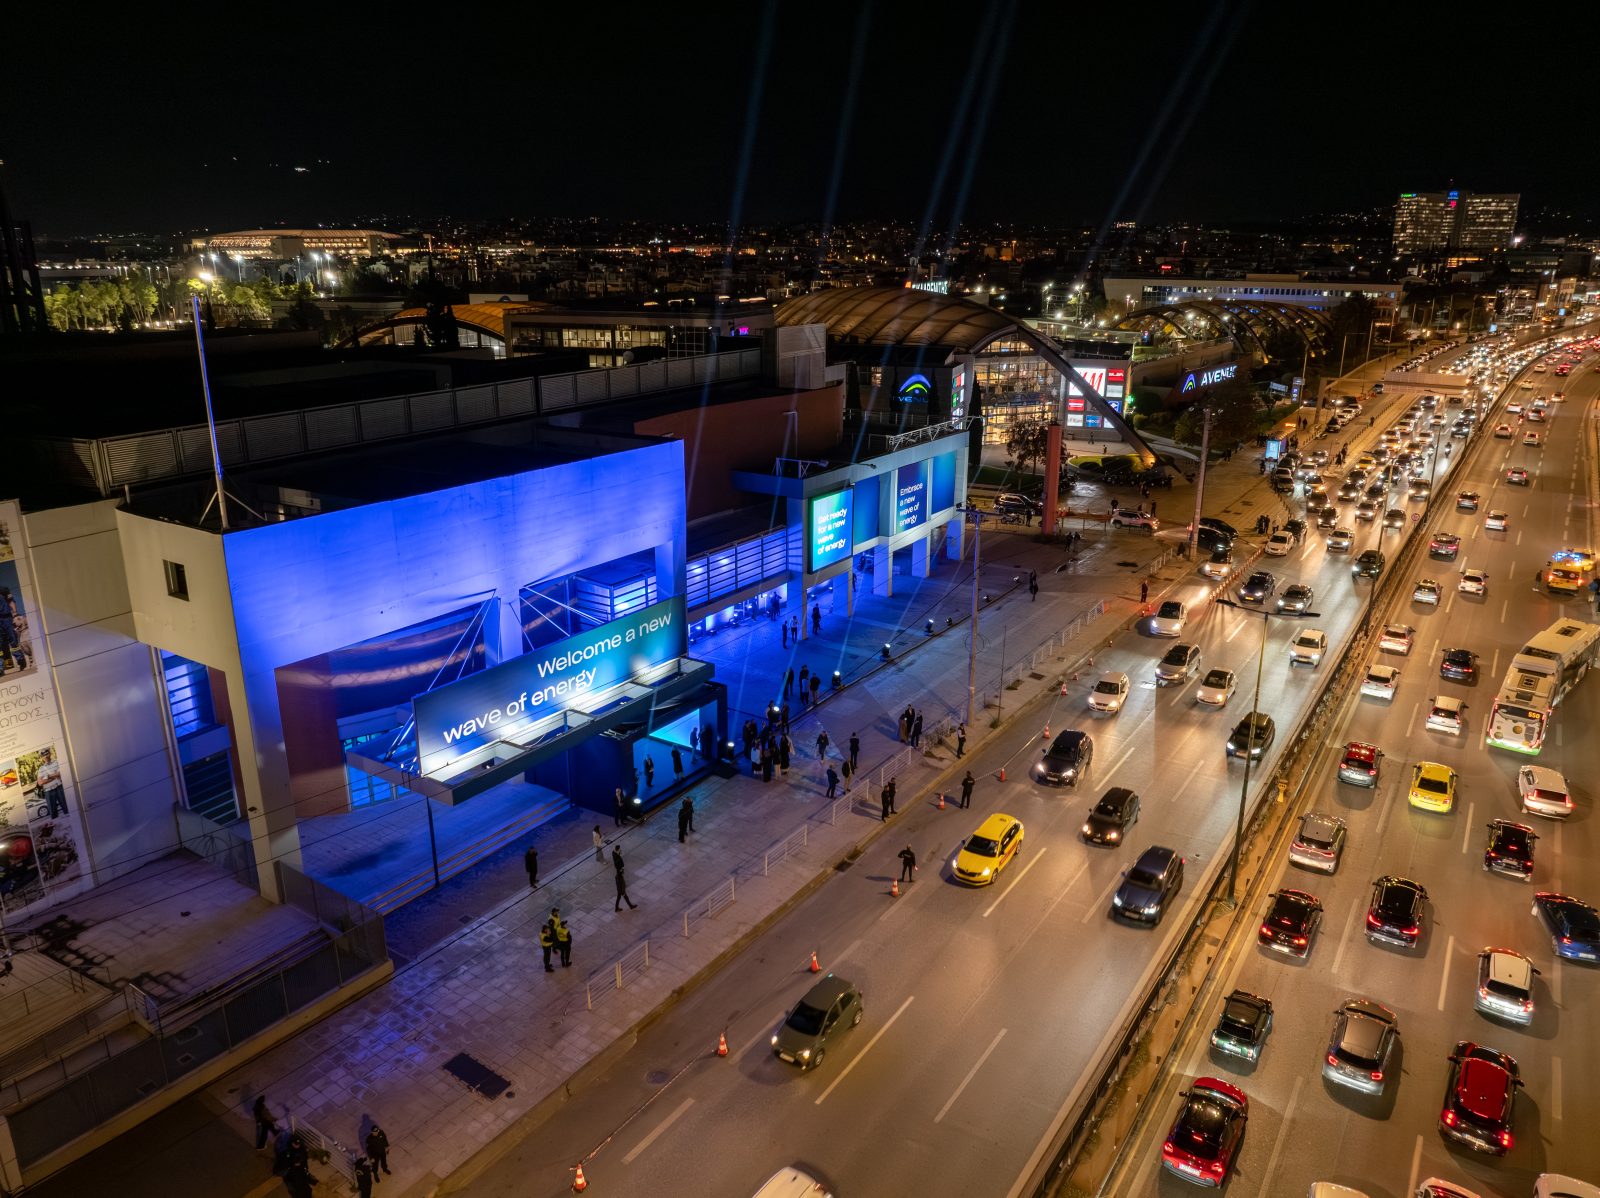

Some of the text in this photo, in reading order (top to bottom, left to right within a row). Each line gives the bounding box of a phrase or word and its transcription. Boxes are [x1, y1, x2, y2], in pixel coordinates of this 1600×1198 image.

[900, 482, 923, 495] Embrace
[904, 496, 915, 504] new
[818, 508, 848, 524] Get ready
[899, 502, 919, 516] wave of
[818, 524, 827, 534] for
[833, 520, 846, 529] new
[899, 515, 917, 526] energy
[817, 534, 834, 544] wave
[817, 538, 846, 555] of energy
[537, 611, 672, 678] Welcome a new
[443, 666, 597, 744] wave of energy
